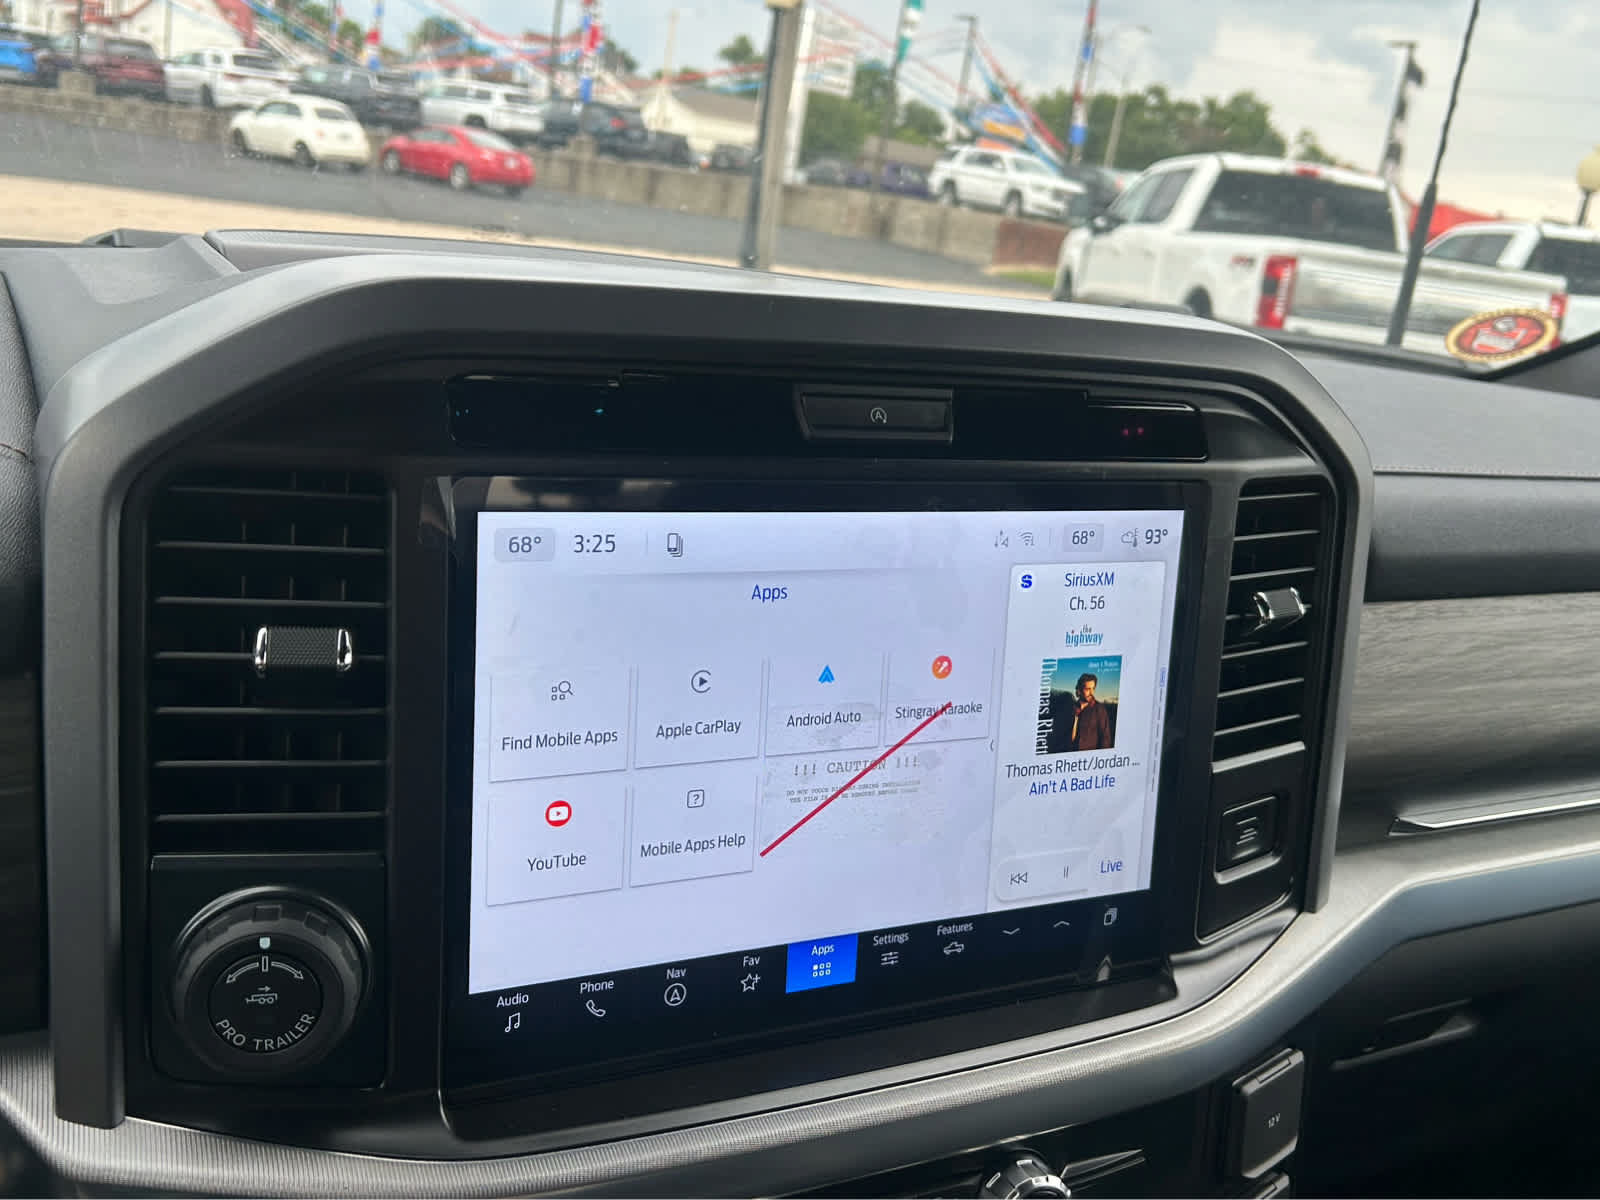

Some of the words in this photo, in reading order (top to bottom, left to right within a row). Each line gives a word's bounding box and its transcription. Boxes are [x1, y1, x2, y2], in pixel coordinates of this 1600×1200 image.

[508, 536, 542, 554] 68°
[573, 534, 616, 554] 3:25
[1072, 530, 1095, 545] 68°
[1145, 528, 1168, 545] 93°
[1064, 571, 1115, 587] SiriusXM
[751, 584, 788, 602] Apps
[1069, 596, 1087, 611] Ch.
[1089, 595, 1105, 611] 56
[1065, 629, 1104, 647] highway
[786, 711, 832, 728] Android
[834, 711, 861, 724] Auto
[895, 706, 939, 720] Stingray
[656, 723, 692, 740] Apple
[694, 719, 741, 737] CarPlay
[502, 736, 532, 751] Find
[535, 731, 581, 749] Mobile
[584, 730, 618, 746] Apps
[1005, 762, 1053, 778] Thomas
[1055, 755, 1130, 775] Rhett/Jordan
[1029, 777, 1057, 796] Ain't
[1059, 780, 1068, 793] A
[1070, 775, 1093, 792] Bad
[1095, 774, 1116, 789] Life
[640, 840, 682, 858] Mobile
[684, 838, 715, 854] Apps
[717, 833, 746, 850] Help
[527, 853, 587, 872] YouTube
[1100, 859, 1123, 873] Live
[937, 921, 973, 936] Features
[873, 931, 909, 947] Settings
[811, 942, 834, 956] Apps
[743, 955, 761, 968] Fav
[666, 967, 686, 980] Nav
[580, 979, 615, 994] Phone
[496, 992, 529, 1008] Audio
[216, 1019, 246, 1046] PRO
[253, 1013, 315, 1051] TRAILER
